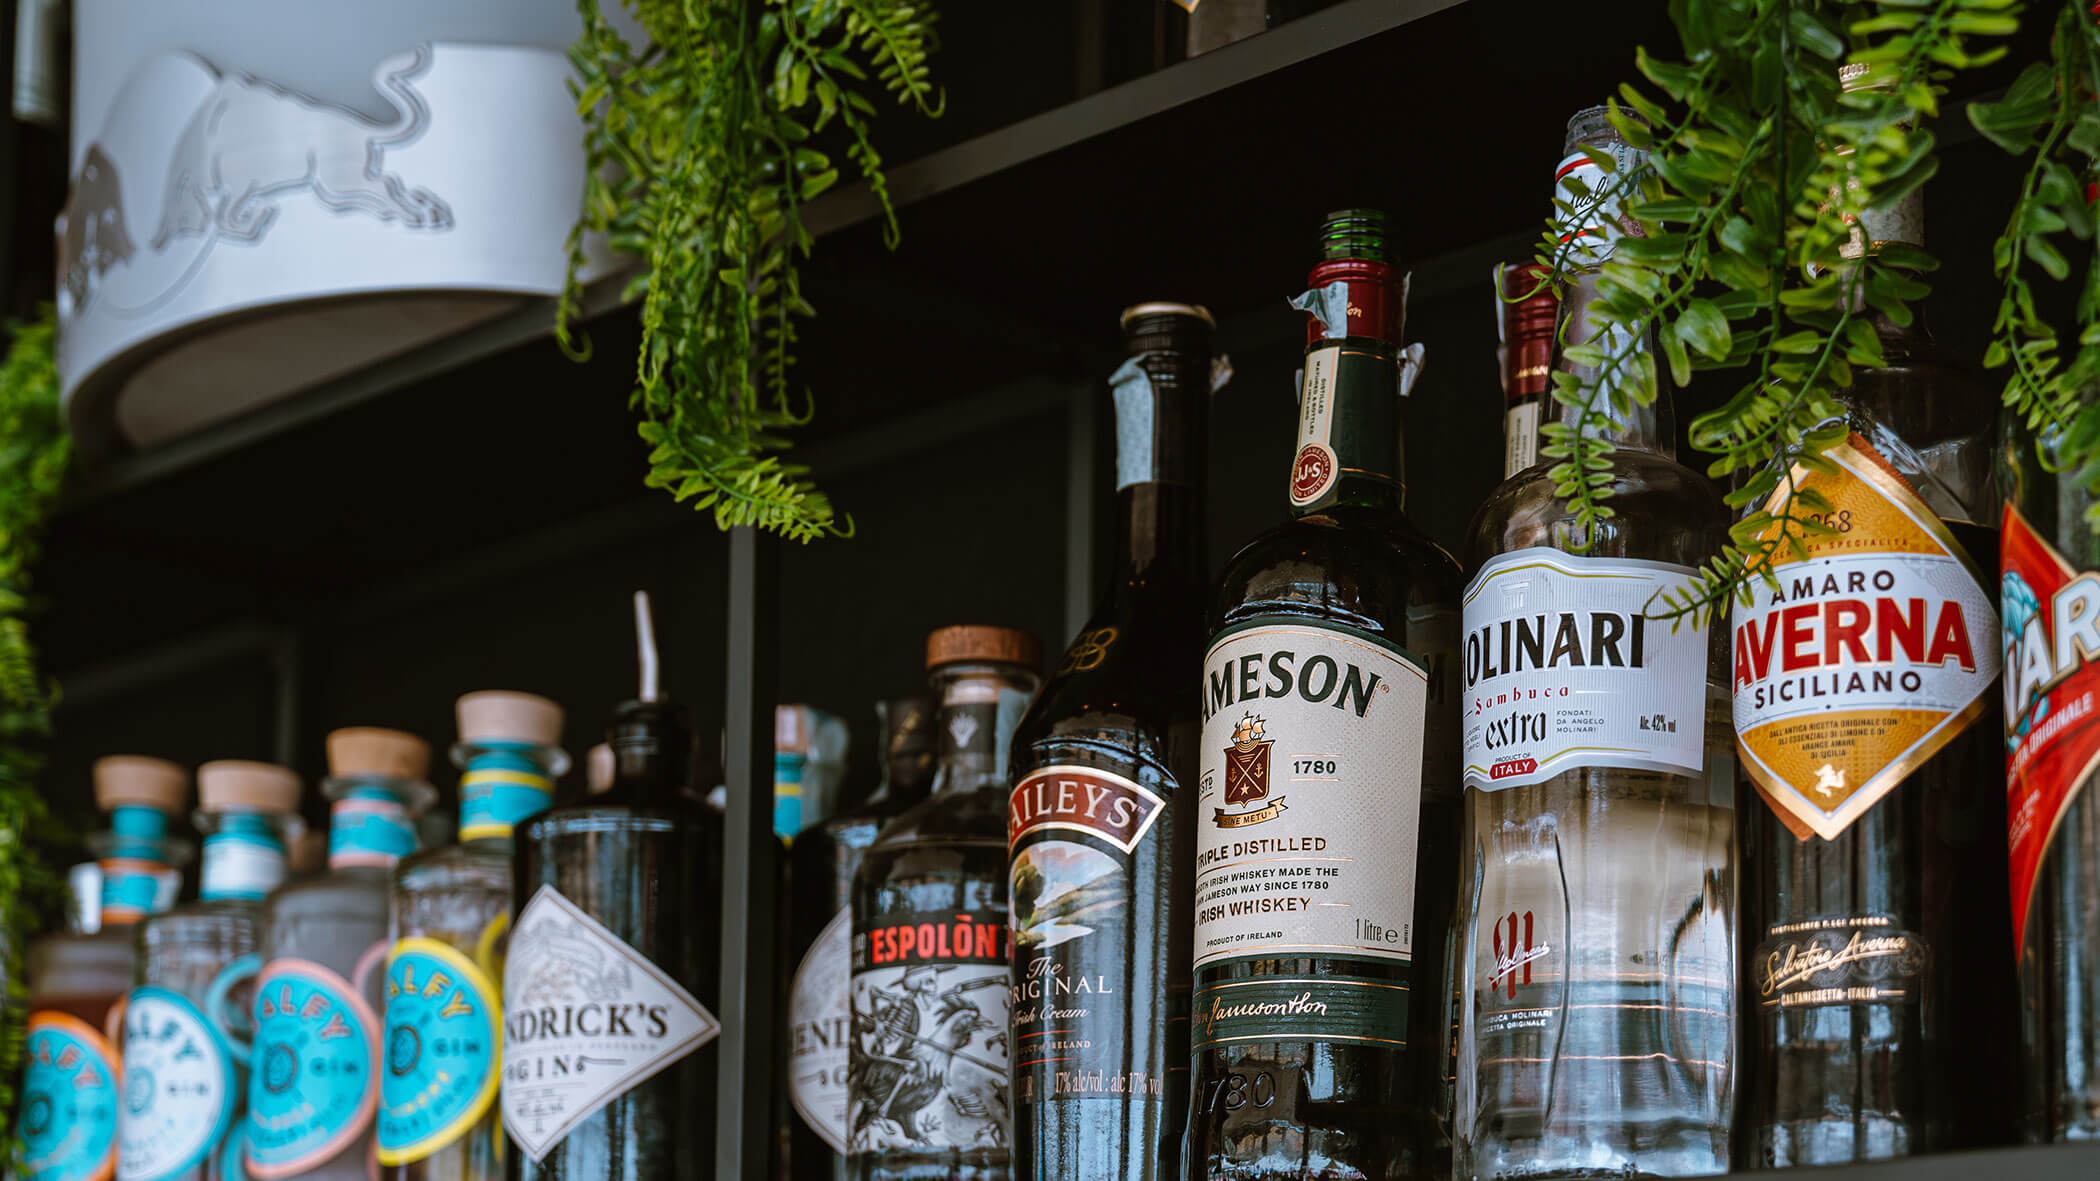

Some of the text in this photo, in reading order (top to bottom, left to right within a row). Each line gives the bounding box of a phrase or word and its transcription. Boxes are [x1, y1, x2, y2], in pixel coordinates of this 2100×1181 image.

[1771, 569, 1895, 606] AMARO
[1734, 597, 1976, 697] AVERNA
[1201, 651, 1382, 724] AMESON
[1754, 670, 1921, 710] SICILIANO
[1474, 686, 1569, 715] Sambuca
[1485, 710, 1547, 750] extra
[1651, 714, 1667, 732] 42%
[2029, 690, 2094, 754] ORIGINALE
[1293, 760, 1337, 774] 1780
[1494, 761, 1530, 776] ITALY
[1495, 754, 1522, 763] PRODUCT
[1233, 837, 1327, 857] DISTILLED
[1231, 868, 1276, 882] WHISKEY
[1278, 867, 1312, 877] MADE
[1315, 867, 1339, 877] THE
[1205, 886, 1238, 902] JAMESON
[1240, 883, 1261, 894] WAY
[1264, 881, 1298, 891] SINCE
[1301, 880, 1329, 890] 1780
[1199, 897, 1312, 927] IRISH WHISKEY
[1206, 931, 1283, 948] PRODUCT OF IRELAND
[1364, 918, 1382, 942] litre
[1829, 930, 1907, 970] Averna
[1026, 955, 1064, 980] The
[1040, 1003, 1091, 1019] Cream
[1055, 1071, 1071, 1094] 17%
[1111, 1069, 1126, 1093] alc
[1128, 1072, 1147, 1094] 17%
